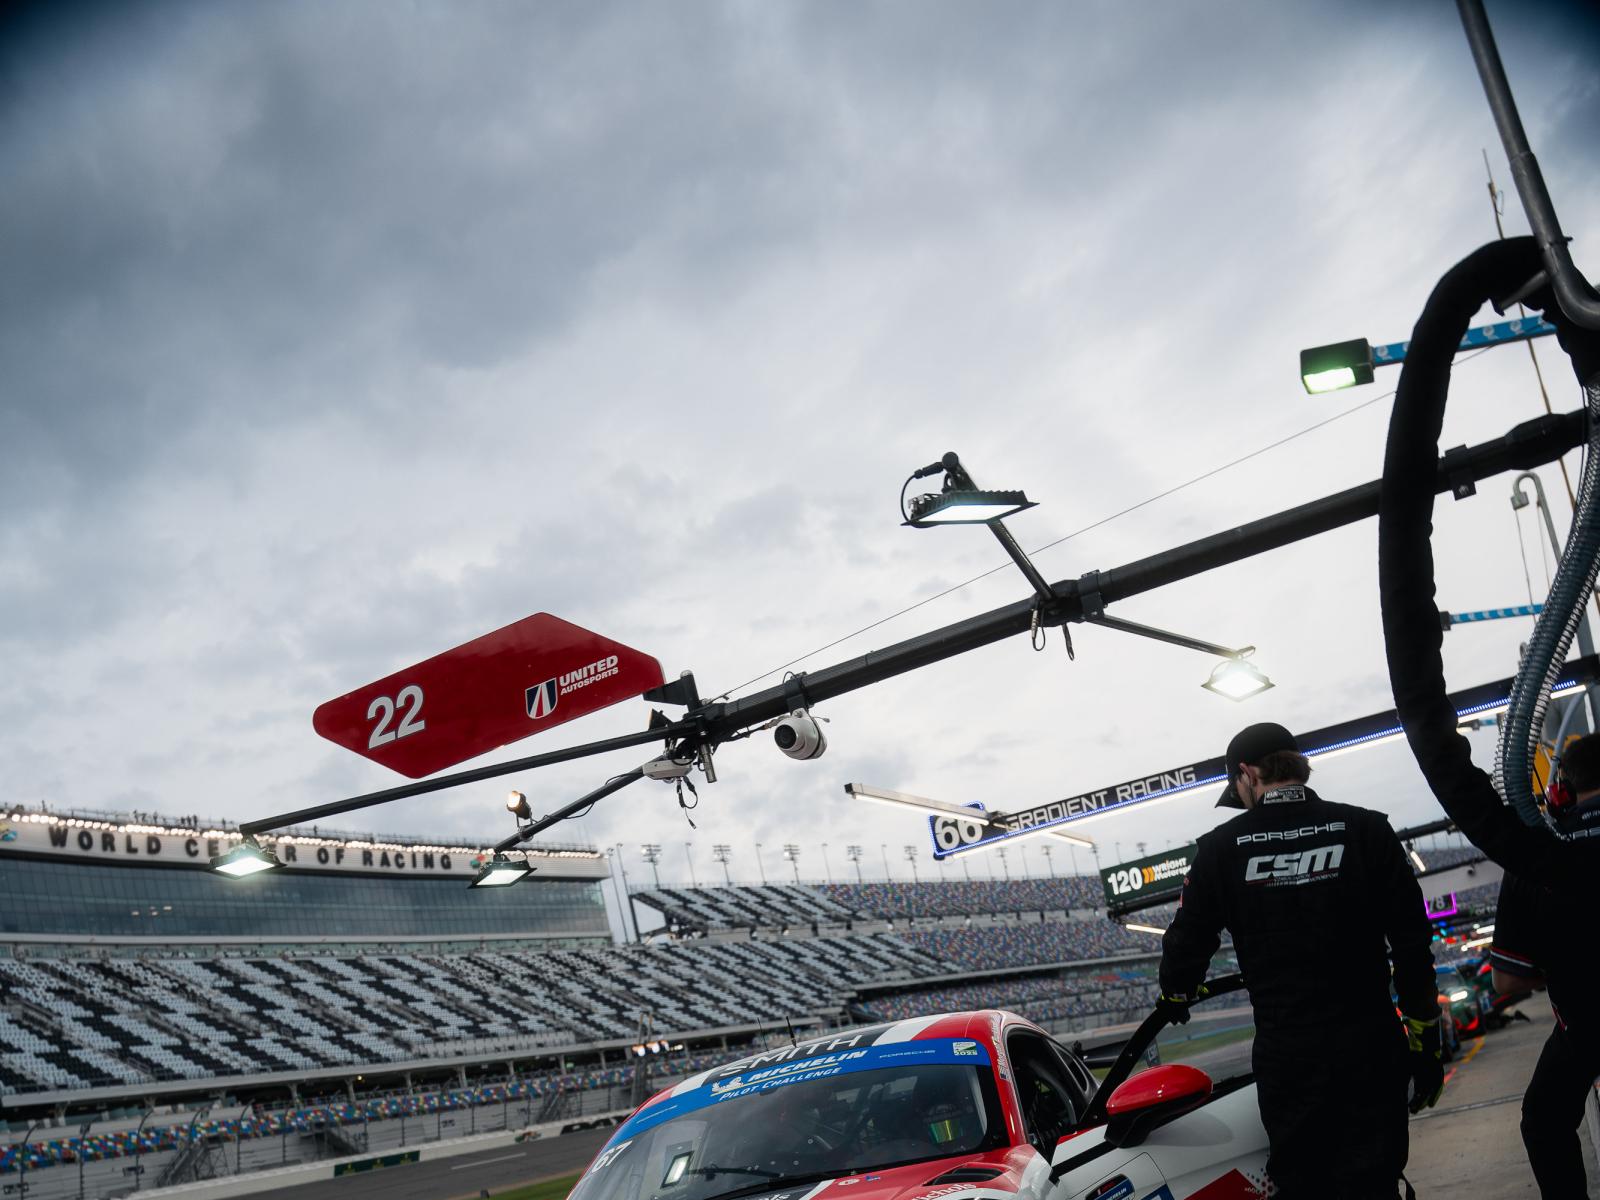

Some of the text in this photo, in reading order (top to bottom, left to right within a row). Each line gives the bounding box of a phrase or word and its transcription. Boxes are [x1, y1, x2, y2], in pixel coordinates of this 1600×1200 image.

[558, 655, 619, 687] UNITED
[559, 666, 620, 696] AUTOSPORTS
[367, 685, 426, 750] 22
[1004, 767, 1197, 832] GRADIENT RACING
[48, 827, 452, 870] WORLD CER OF RACING
[1236, 821, 1346, 846] PORSCHE
[1244, 843, 1345, 881] CSM
[1107, 866, 1143, 896] 120
[719, 1034, 864, 1077] SMITH
[747, 1050, 868, 1082] MICHELIN
[719, 1067, 843, 1102] PILOT CHALLENGE
[591, 1140, 634, 1173] 67
